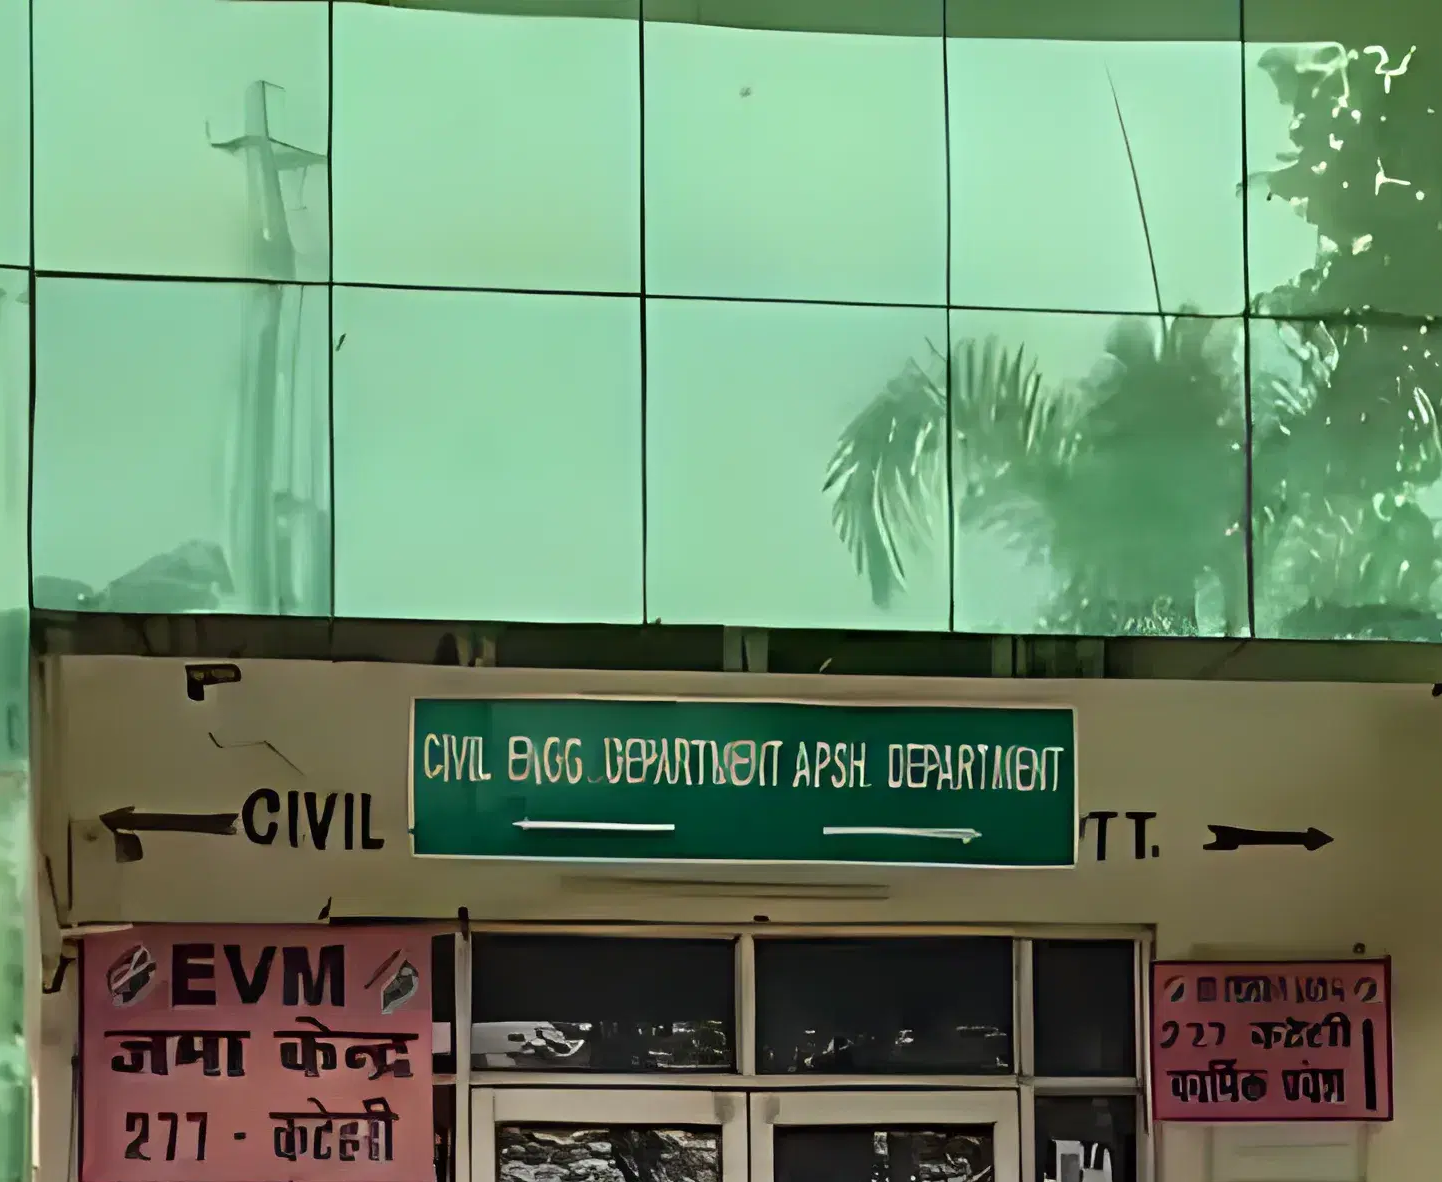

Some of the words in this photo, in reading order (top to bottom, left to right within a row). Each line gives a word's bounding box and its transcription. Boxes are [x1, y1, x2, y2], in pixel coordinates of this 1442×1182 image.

[423, 733, 491, 782] CIVIL
[241, 788, 385, 850] CIVIL
[171, 944, 345, 1007] EVM
[104, 1030, 250, 1077] जमा
[124, 1112, 208, 1161] 277
